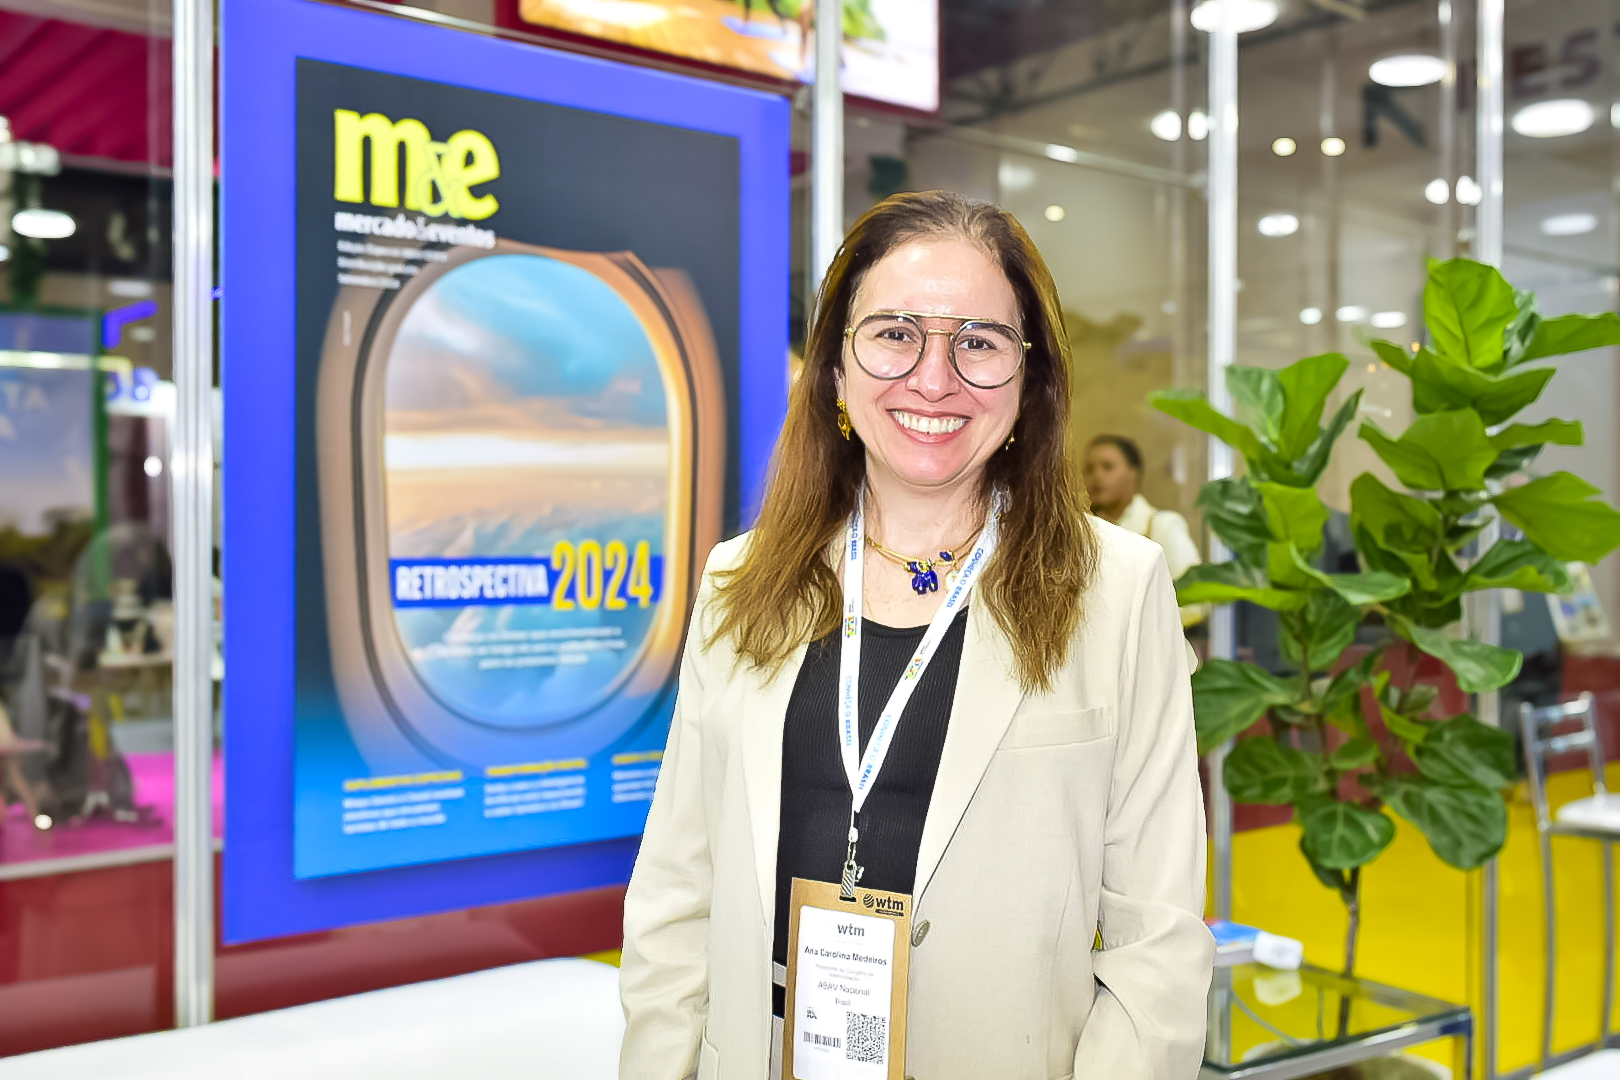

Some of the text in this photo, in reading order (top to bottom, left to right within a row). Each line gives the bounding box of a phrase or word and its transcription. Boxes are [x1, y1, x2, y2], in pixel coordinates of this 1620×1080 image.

[334, 108, 500, 220] m&e
[396, 539, 653, 611] RETROSPECTIVA 2024
[875, 896, 904, 911] wtm
[837, 923, 865, 937] wtm
[804, 945, 887, 966] Ana Carolina Medeiros
